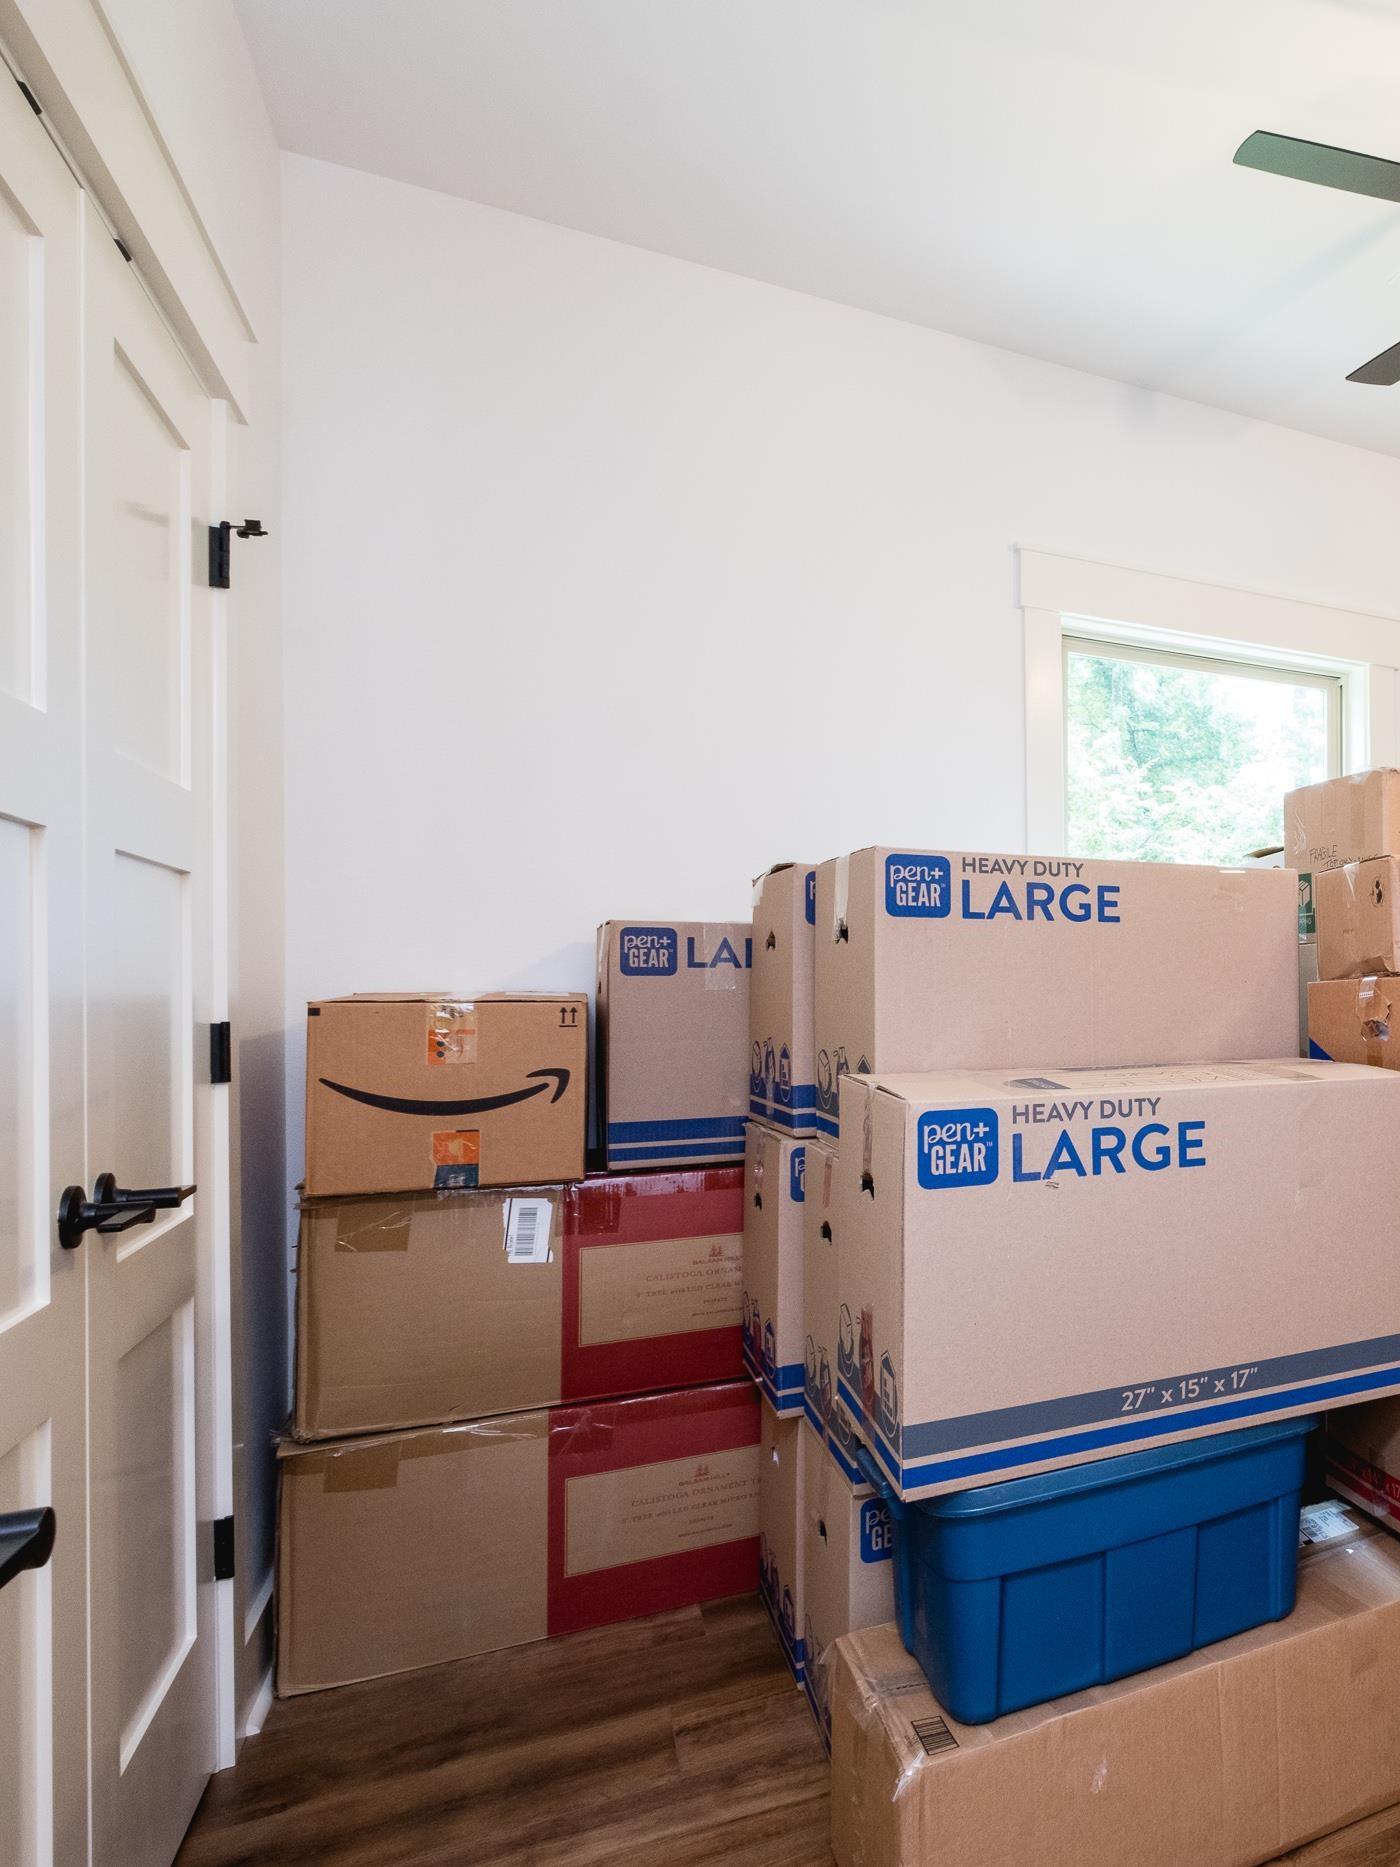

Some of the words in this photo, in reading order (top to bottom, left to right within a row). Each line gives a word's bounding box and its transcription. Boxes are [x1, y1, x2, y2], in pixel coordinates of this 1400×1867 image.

[962, 857, 1029, 876] HEAVY
[1033, 860, 1084, 878] DUTY
[895, 882, 941, 907] GEAR
[961, 879, 1121, 923] LARGE
[629, 948, 669, 968] GEAR
[1012, 1100, 1095, 1125] HEAVY
[1099, 1097, 1161, 1119] DUTY
[930, 1141, 987, 1176] GEAR
[1012, 1120, 1206, 1183] LARGE
[1121, 1386, 1155, 1411] 27"
[1161, 1389, 1173, 1403] x
[1179, 1376, 1209, 1399] 15"
[1213, 1378, 1225, 1393] x
[1231, 1367, 1259, 1389] 17"
